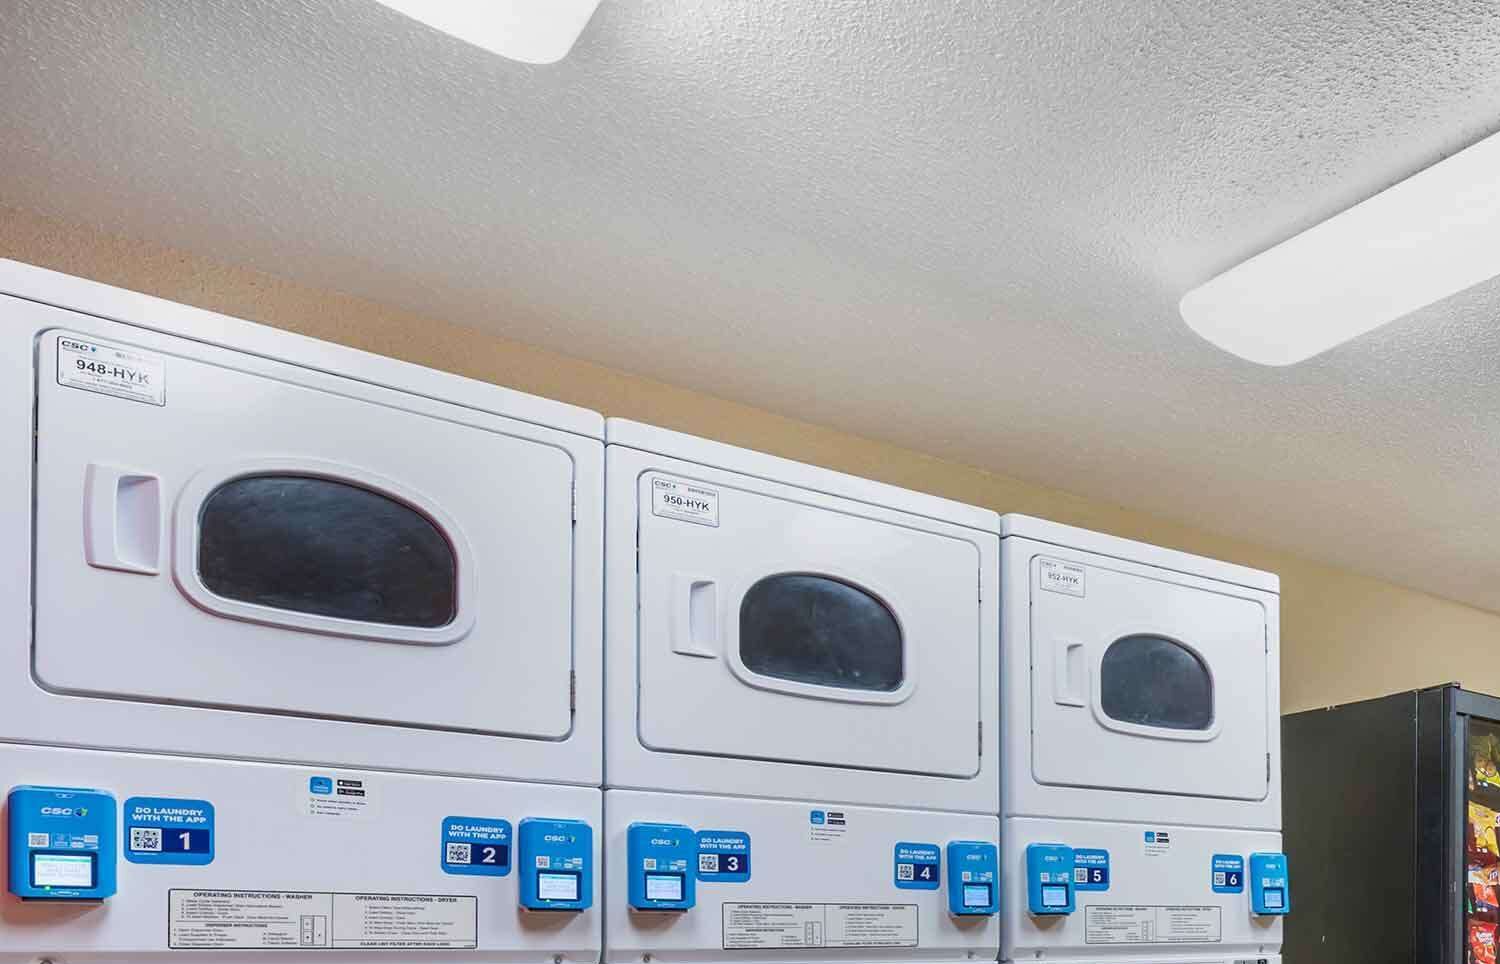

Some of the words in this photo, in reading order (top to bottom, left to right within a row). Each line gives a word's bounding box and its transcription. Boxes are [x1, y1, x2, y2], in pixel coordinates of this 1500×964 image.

[61, 340, 89, 351] CSC
[75, 359, 151, 384] 948-HYK
[664, 494, 709, 511] 950-HYK
[41, 807, 73, 816] CSC
[135, 807, 151, 815] DO
[153, 808, 204, 816] LAUNDRY
[132, 814, 162, 822] WITH
[164, 815, 185, 823] THE
[186, 816, 207, 824] APP
[465, 825, 504, 833] LAUNDRY
[178, 832, 191, 850] 1
[482, 847, 496, 863] 2
[727, 856, 739, 871] 3
[920, 866, 931, 879] 4
[1093, 869, 1102, 882] 5
[1229, 873, 1238, 885] 6
[233, 892, 281, 900] INSTRUCTIONS
